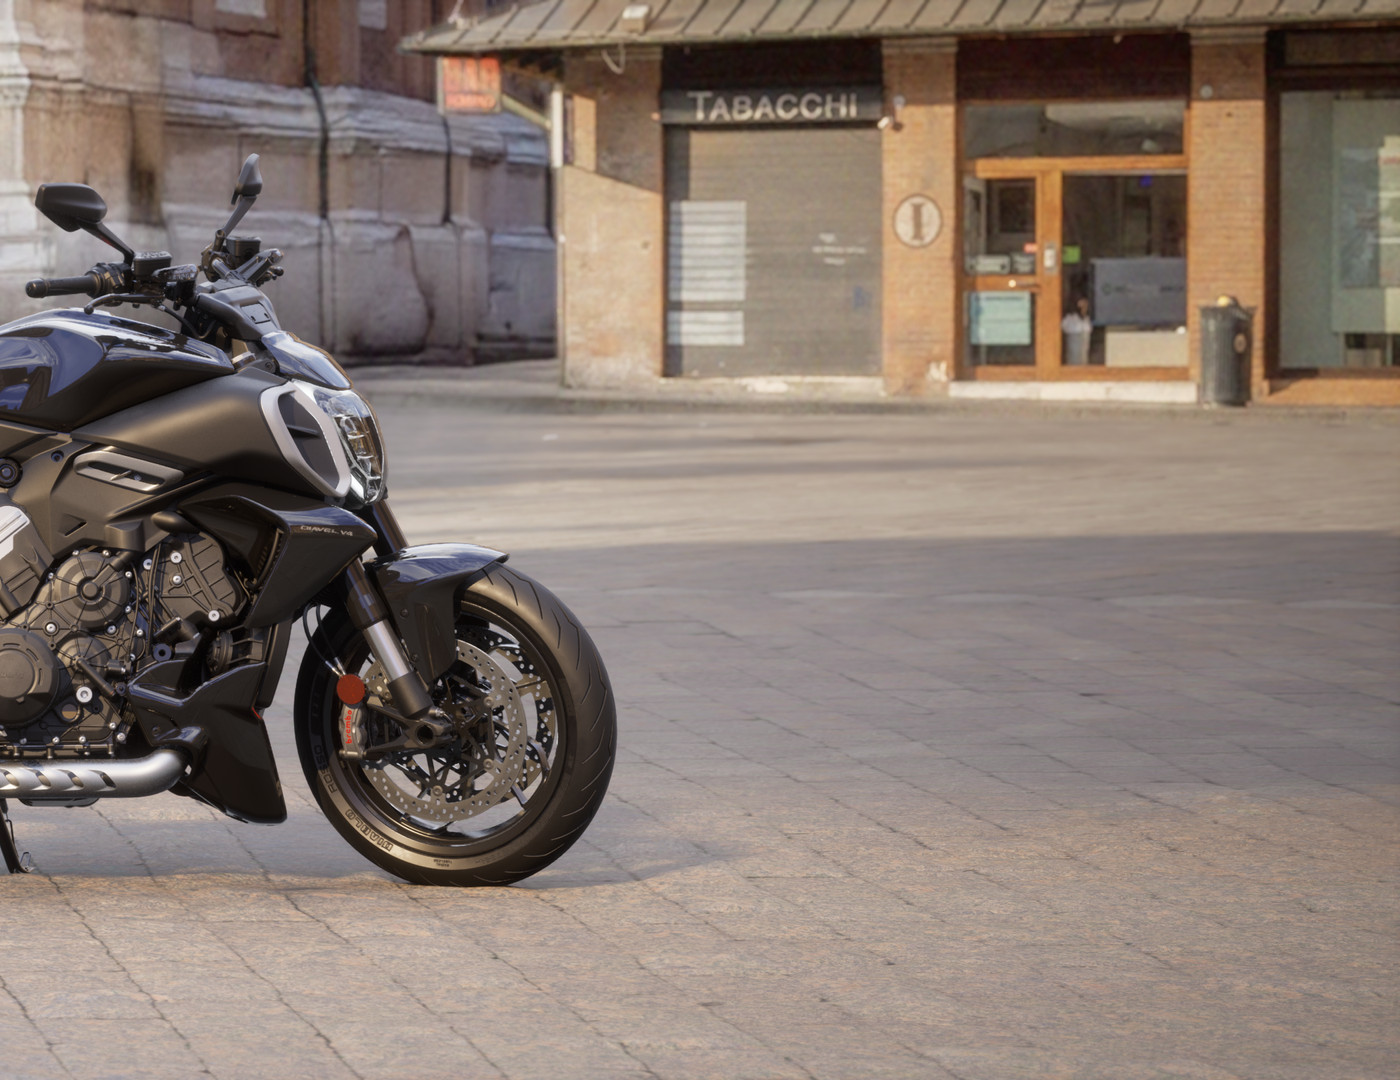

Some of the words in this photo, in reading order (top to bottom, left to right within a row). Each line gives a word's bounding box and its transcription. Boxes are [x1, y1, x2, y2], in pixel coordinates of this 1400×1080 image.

[687, 91, 857, 122] TABACCHI
[300, 525, 339, 534] DIAVEL
[344, 709, 353, 744] brembo
[313, 744, 338, 794] ROSSO
[345, 808, 394, 852] DIABLO
